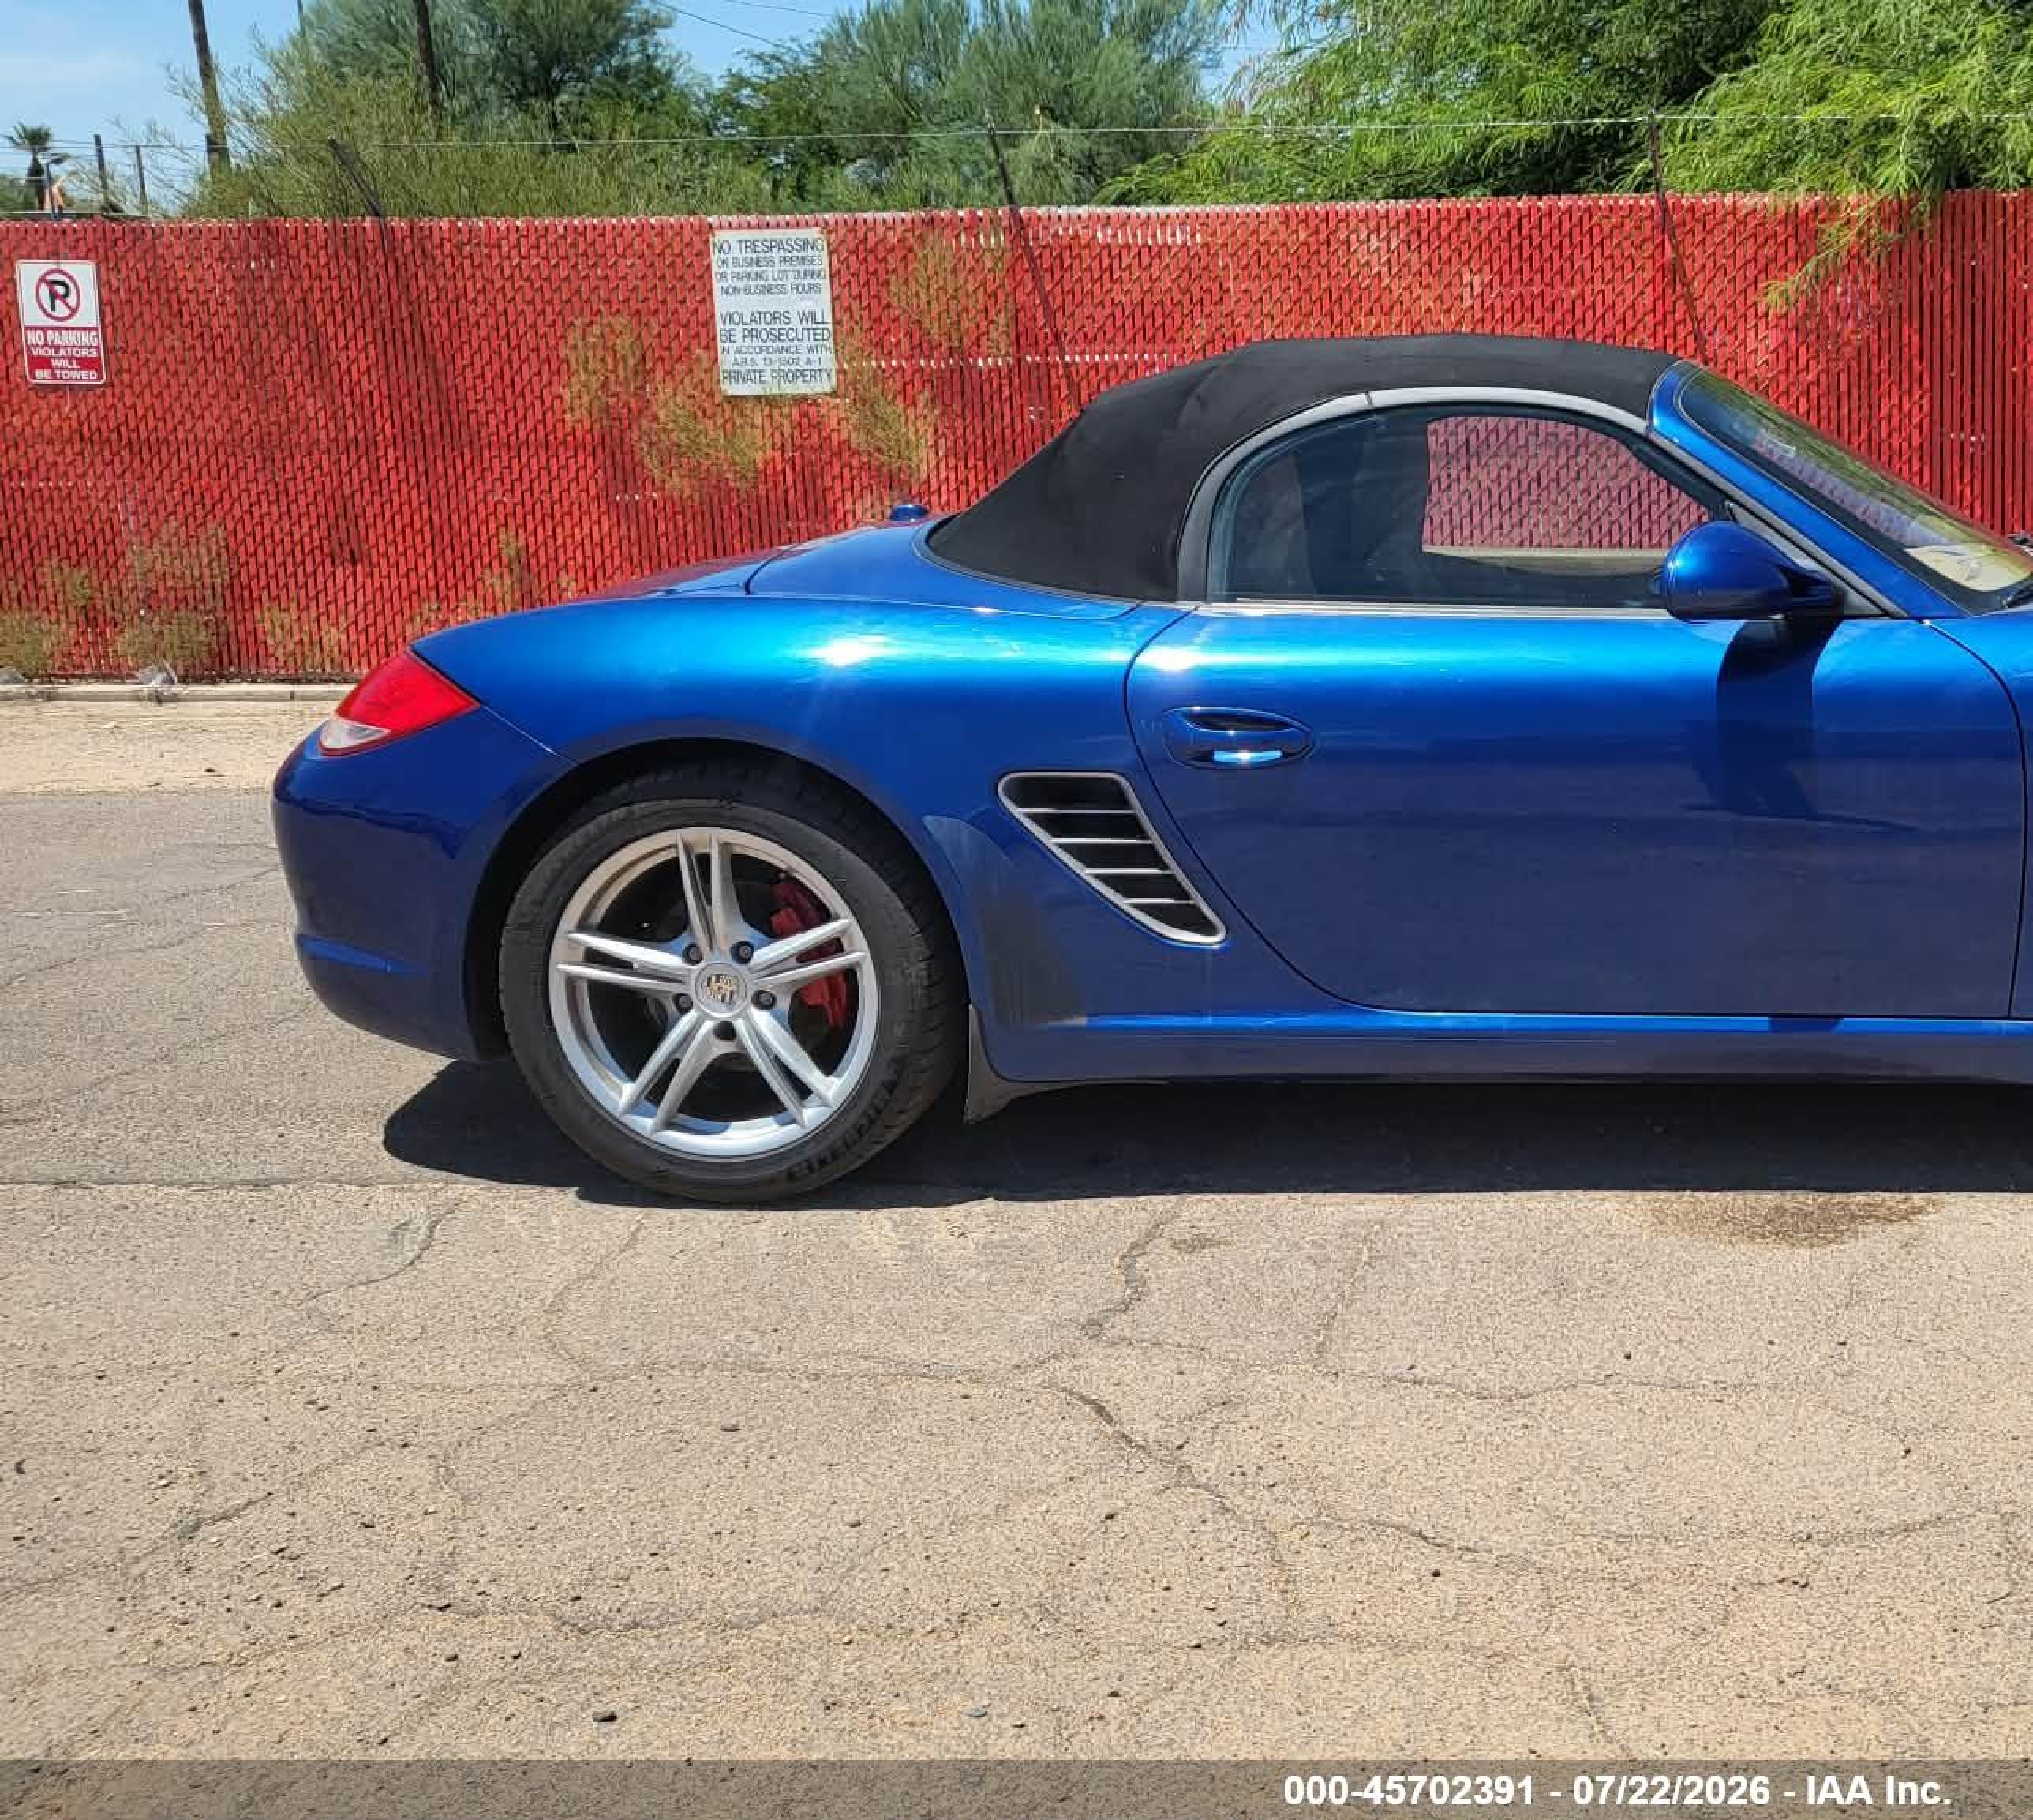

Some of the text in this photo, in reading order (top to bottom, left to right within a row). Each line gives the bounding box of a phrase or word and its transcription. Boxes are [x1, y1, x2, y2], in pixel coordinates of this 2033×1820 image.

[715, 238, 825, 253] NO TRESPASSING
[732, 256, 775, 267] BUSINESS
[779, 255, 823, 266] PREMISES
[731, 270, 768, 281] PARKING
[771, 269, 789, 280] LOT
[792, 268, 826, 280] DURING
[721, 282, 822, 295] NON-BUSINESS HOURS
[719, 309, 831, 325] VIOLATORS WILL
[27, 331, 99, 345] NO PARKING
[719, 328, 832, 343] BE PROSECUTED
[29, 347, 98, 356] VIOLATORS
[721, 344, 833, 354] IN ACCORDANCE WITH
[51, 358, 81, 369] WILL
[35, 369, 98, 380] BE TOWED
[722, 368, 833, 384] PRIVATE PROPERTY
